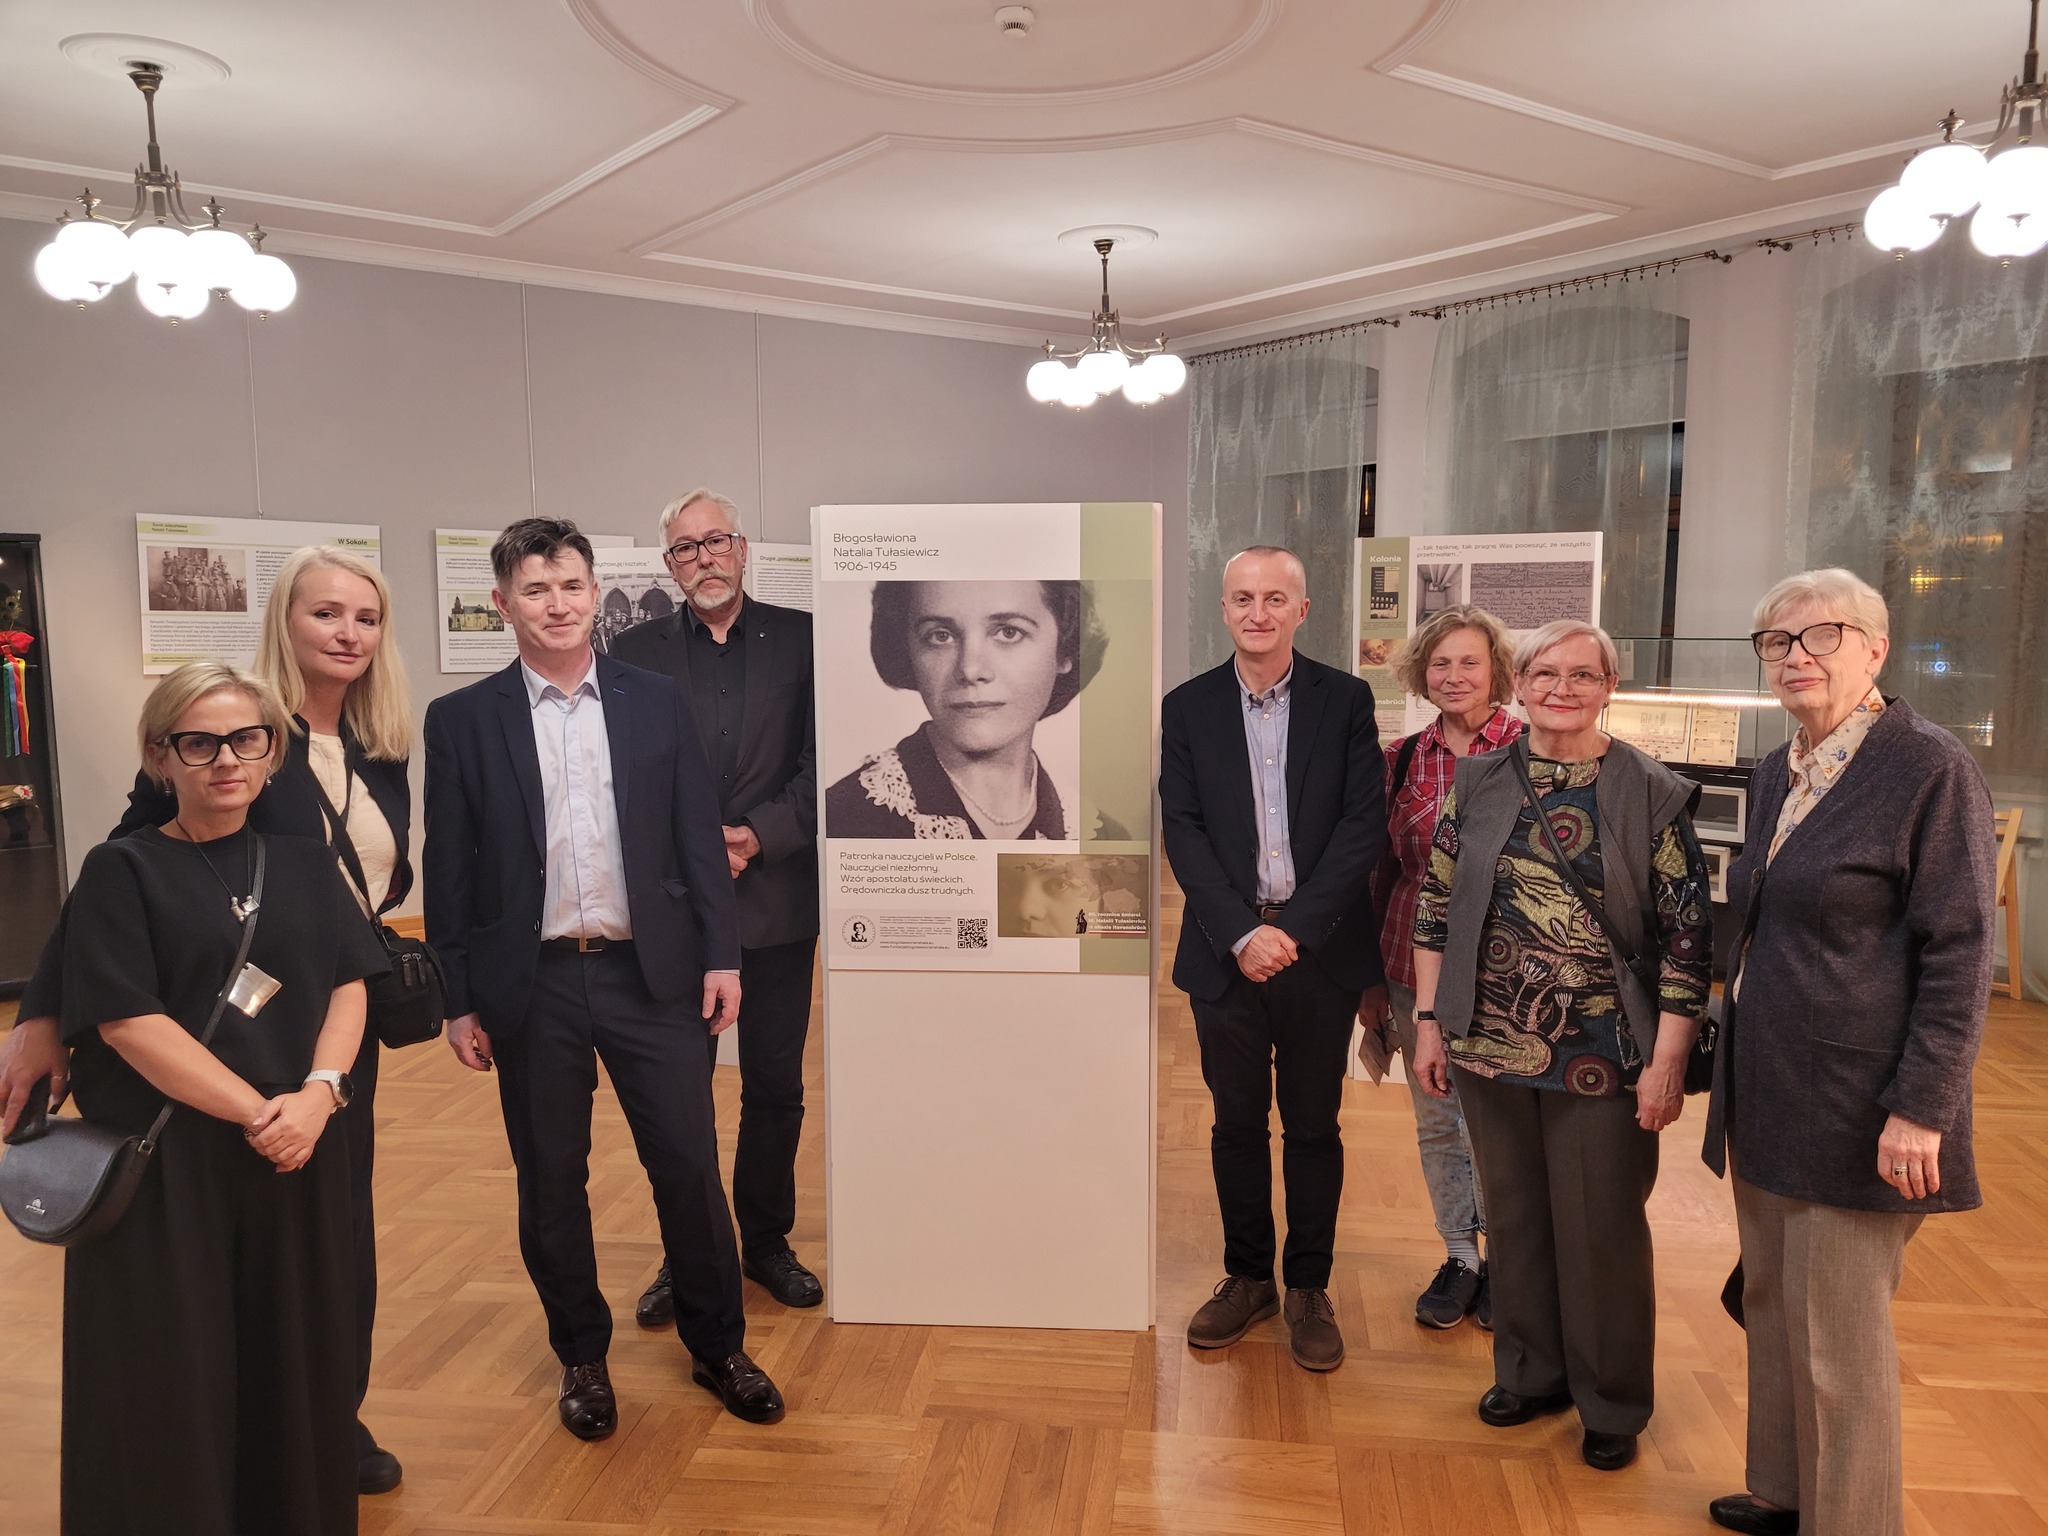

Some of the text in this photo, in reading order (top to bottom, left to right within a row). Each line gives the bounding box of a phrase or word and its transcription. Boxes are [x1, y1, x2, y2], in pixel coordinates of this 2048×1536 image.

[345, 538, 368, 546] Sokole
[833, 532, 917, 545] Błogosławiona
[833, 547, 940, 557] Natalia Tułasiewicz
[1370, 555, 1402, 563] Kolonia
[834, 561, 897, 571] 1906-1945
[840, 851, 884, 861] Patronka
[884, 852, 935, 862] nauczycieli
[944, 852, 978, 861] Polsce.
[840, 863, 889, 873] Nauczyciel
[840, 874, 965, 884] Wzór apostolatu świeckich.
[840, 885, 976, 896] Orędowniczka dusz trudnych.
